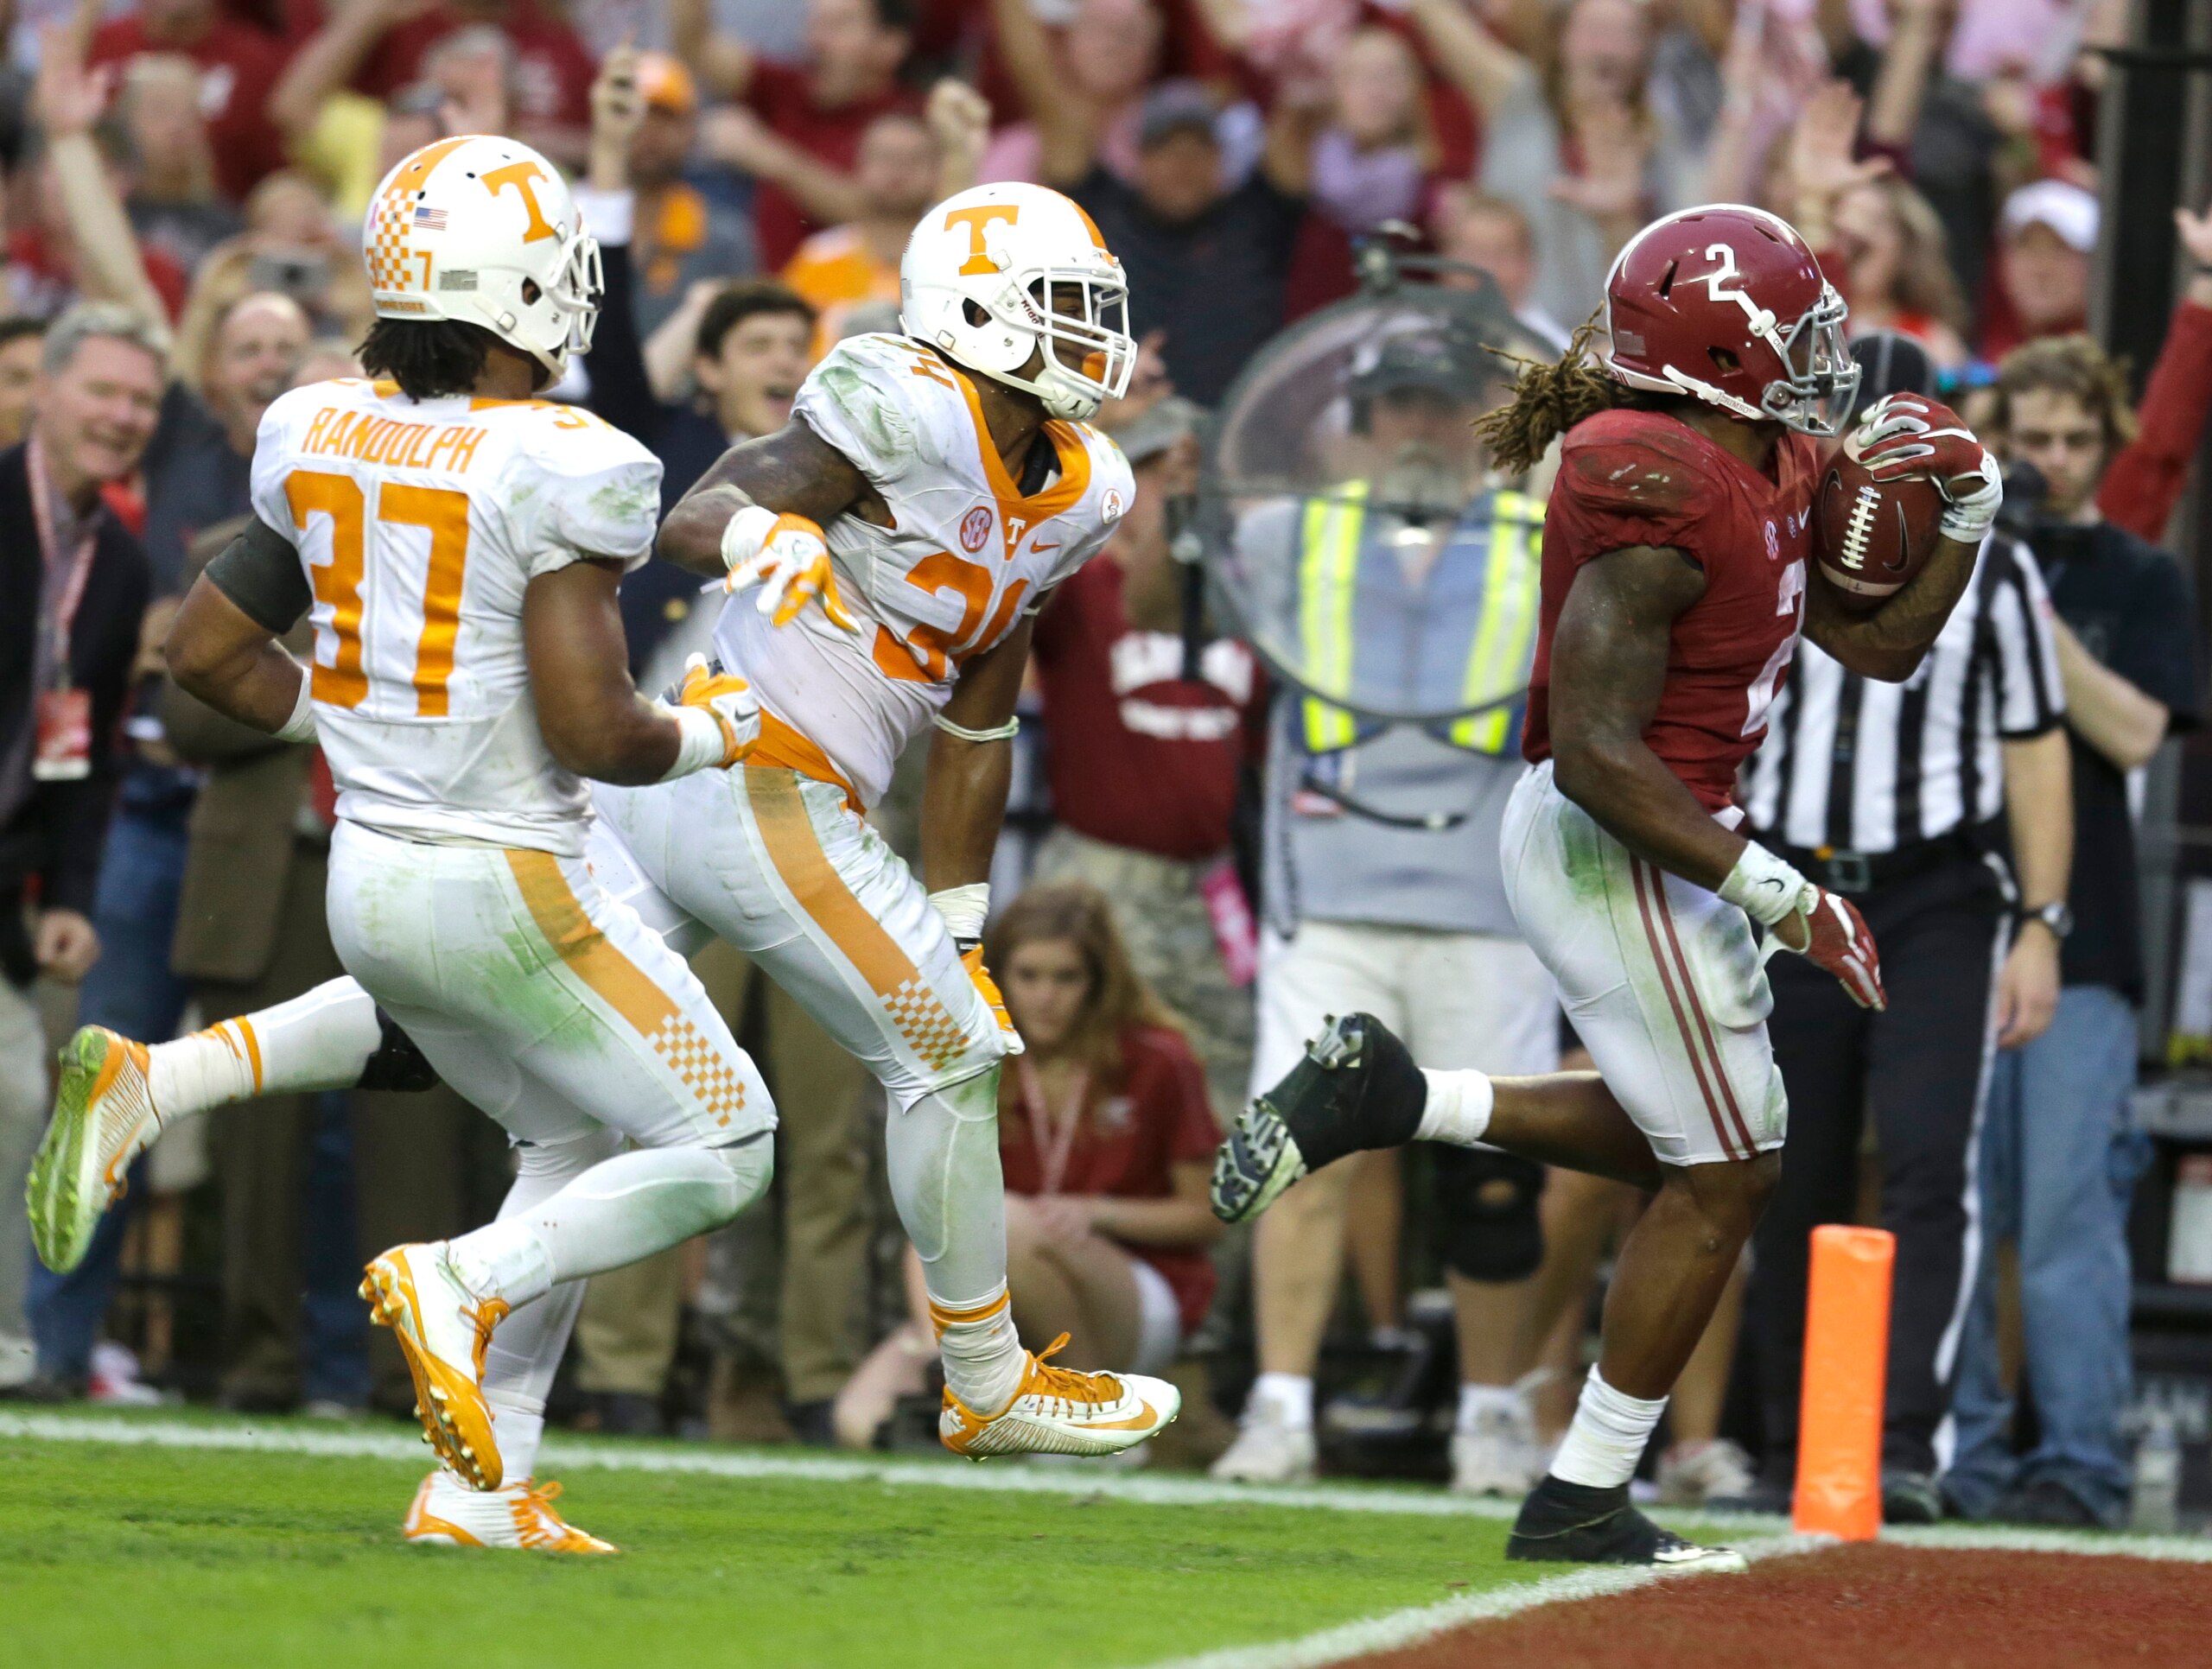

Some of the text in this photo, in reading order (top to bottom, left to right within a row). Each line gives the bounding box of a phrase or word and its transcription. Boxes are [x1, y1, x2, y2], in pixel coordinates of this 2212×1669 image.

[480, 161, 557, 244] T
[944, 204, 1020, 276] T
[1705, 243, 1740, 301] 2
[301, 407, 488, 474] RANDOLPH
[962, 508, 992, 550] SEC
[1008, 517, 1027, 545] T
[283, 469, 469, 716] 37
[1740, 558, 1807, 737] 2
